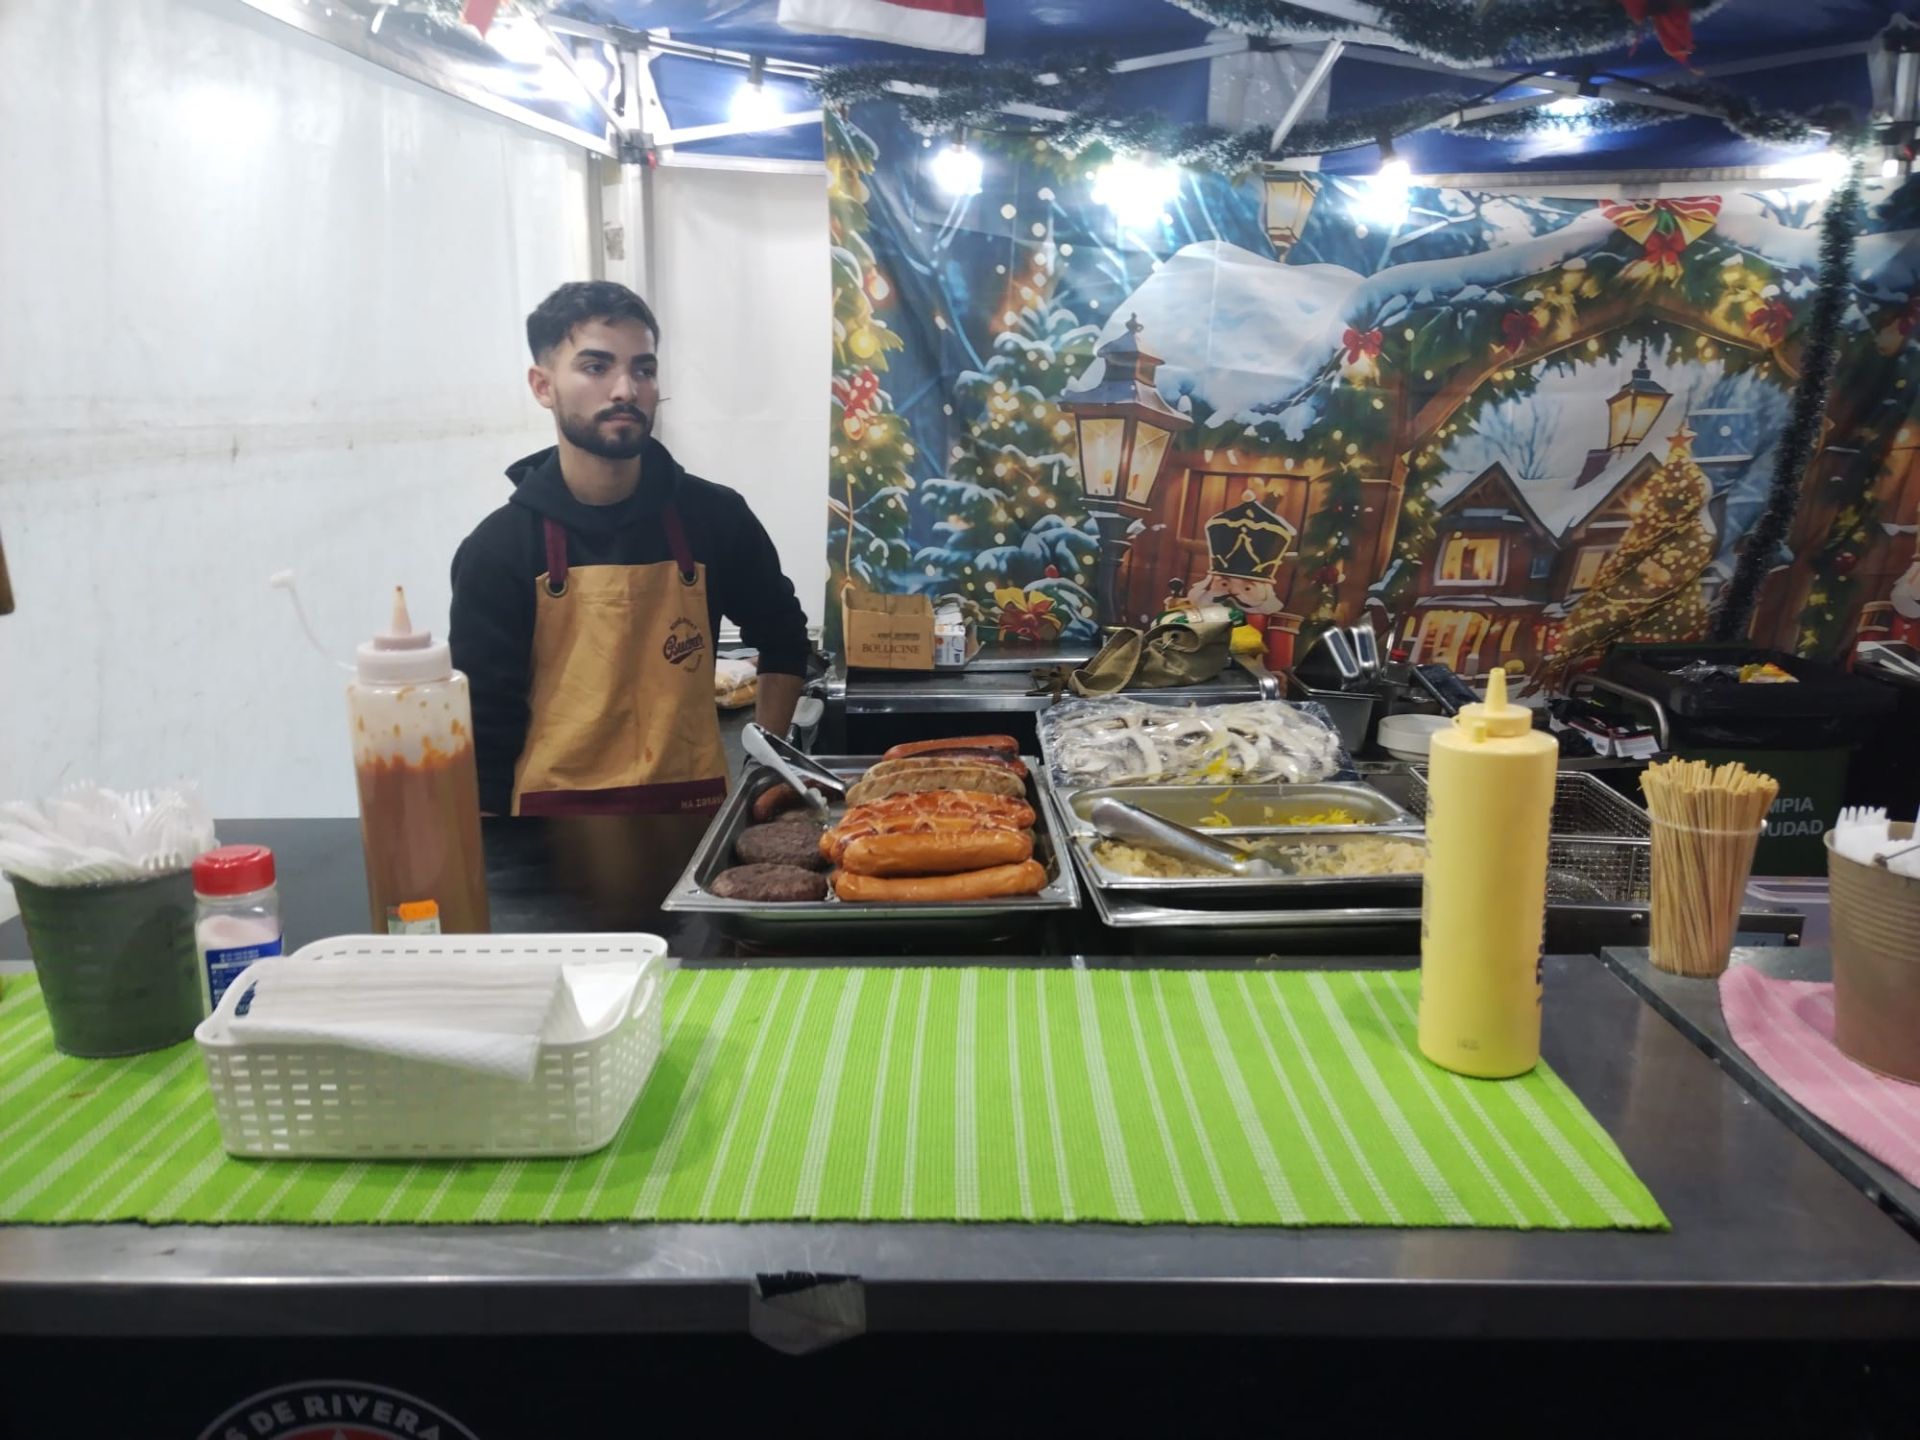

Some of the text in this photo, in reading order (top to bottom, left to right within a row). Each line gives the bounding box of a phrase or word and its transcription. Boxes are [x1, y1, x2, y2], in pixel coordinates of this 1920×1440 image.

[1769, 797, 1814, 813] MPIA
[248, 1399, 296, 1435] DE
[303, 1394, 440, 1440] RIVERA
